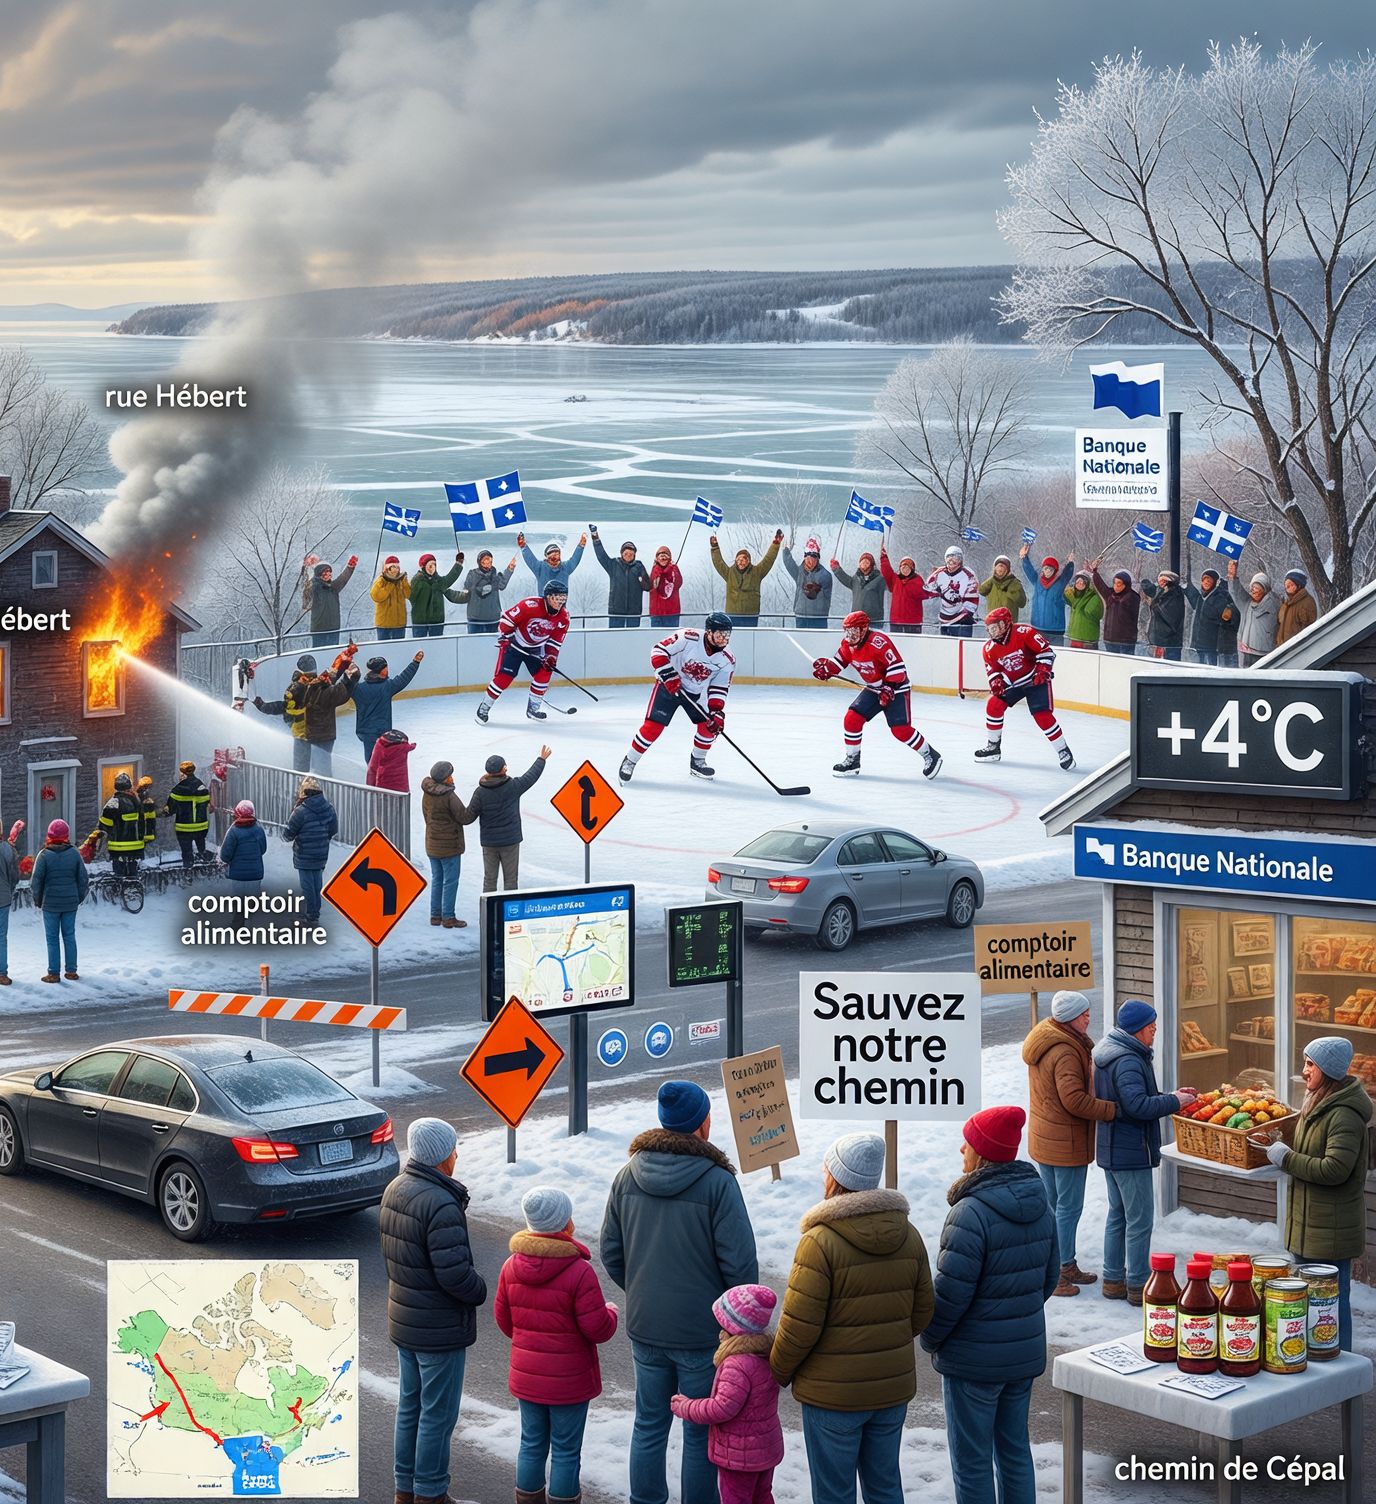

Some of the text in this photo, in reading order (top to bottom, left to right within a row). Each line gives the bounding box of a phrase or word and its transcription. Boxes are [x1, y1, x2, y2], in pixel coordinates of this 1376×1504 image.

[1083, 436, 1147, 456] Banque
[1083, 458, 1161, 475] Nationale
[1157, 699, 1325, 773] +4°C
[1122, 843, 1334, 882] Banque Nationale
[987, 929, 1077, 957] comptoir
[979, 957, 1091, 981] alimentaire
[813, 981, 965, 1021] Sauvez
[834, 1027, 947, 1063] notre
[814, 1068, 965, 1106] chemin
